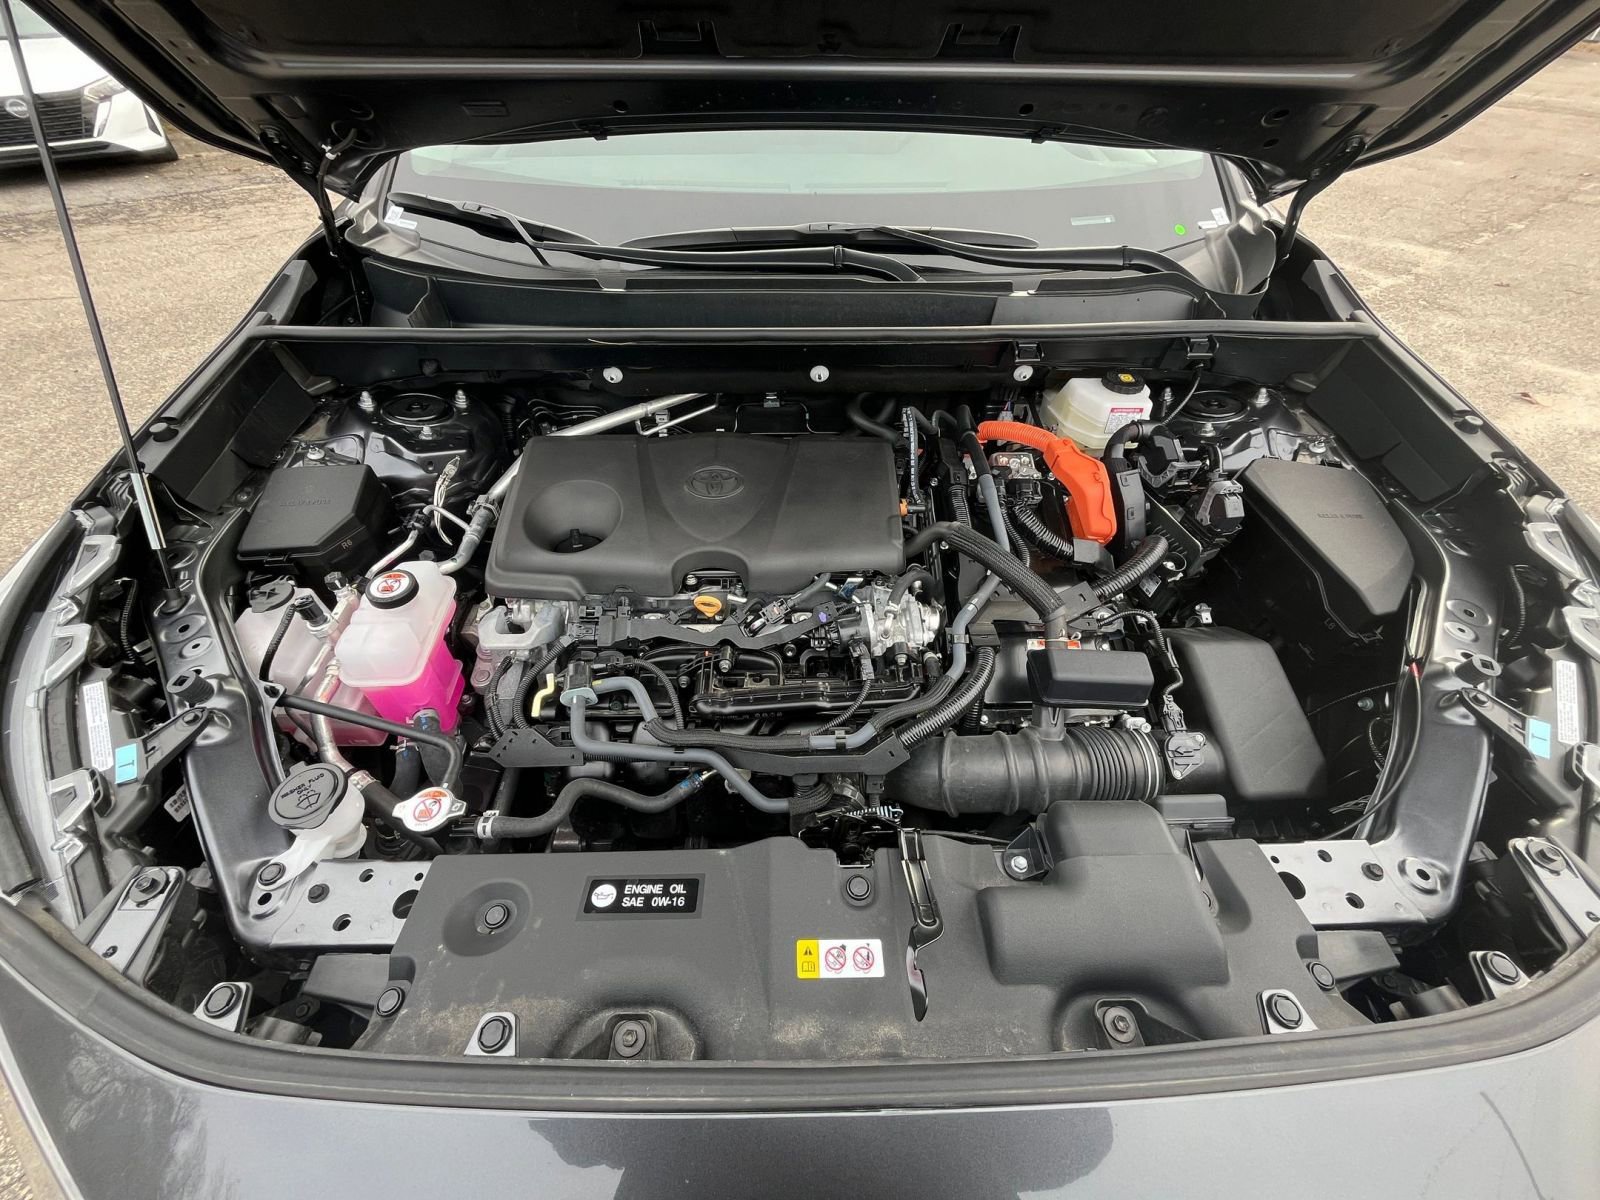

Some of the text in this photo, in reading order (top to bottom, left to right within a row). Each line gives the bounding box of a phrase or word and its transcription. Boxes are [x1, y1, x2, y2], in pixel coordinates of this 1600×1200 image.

[624, 883, 687, 895] ENGINE OIL
[621, 896, 685, 907] SAE 0W-16
